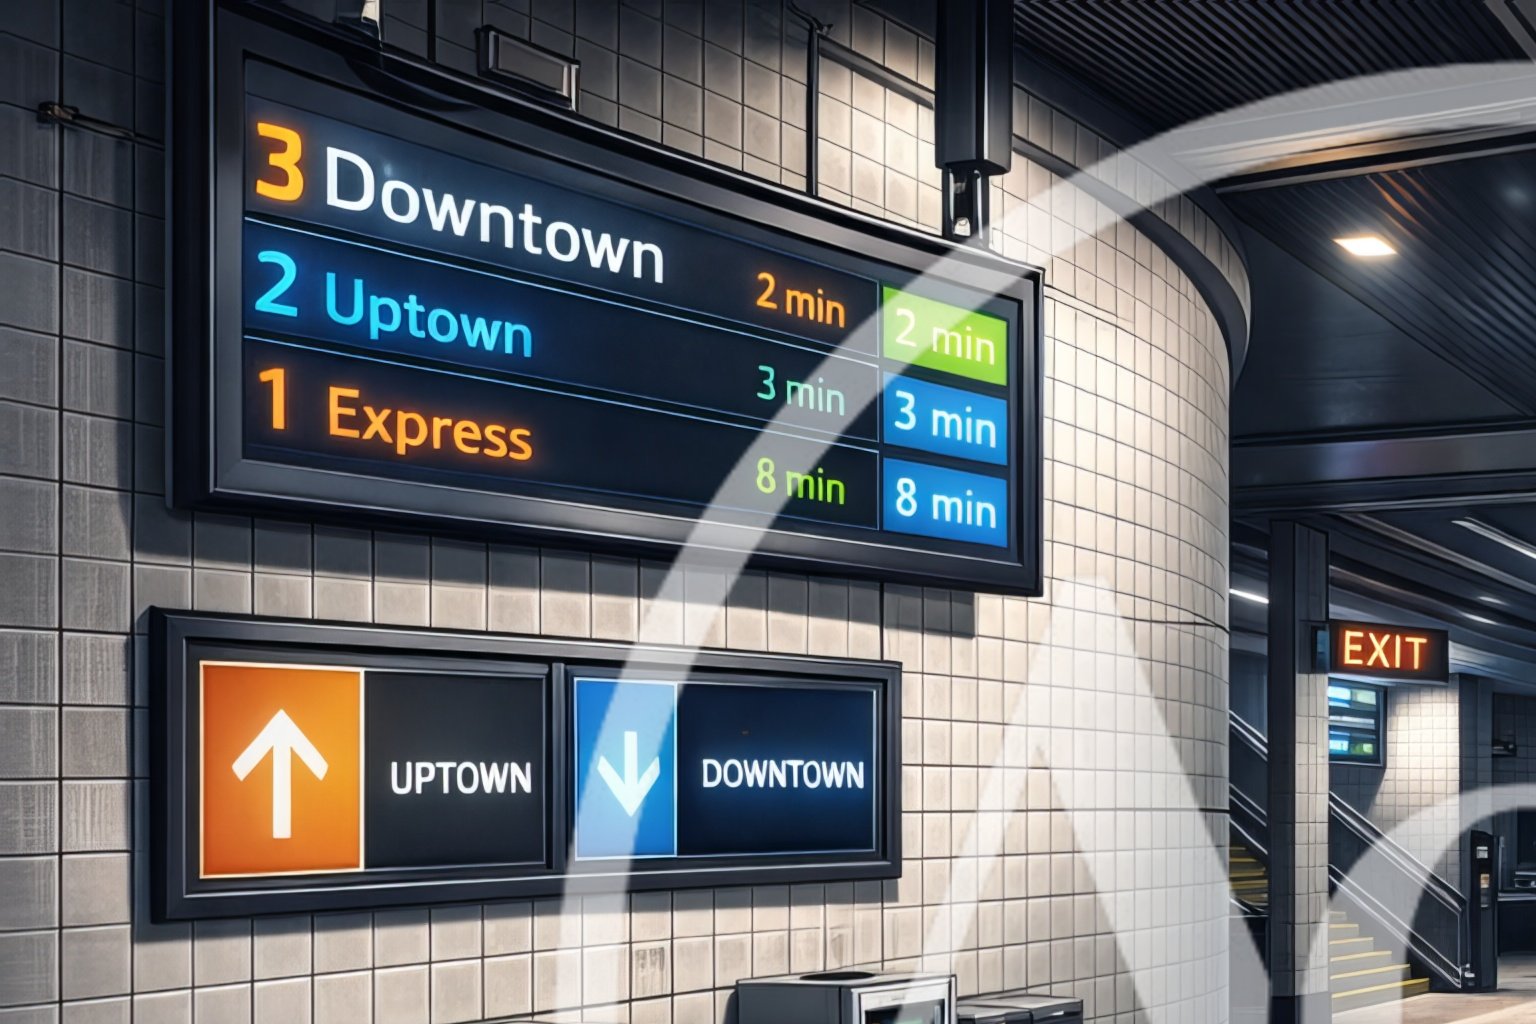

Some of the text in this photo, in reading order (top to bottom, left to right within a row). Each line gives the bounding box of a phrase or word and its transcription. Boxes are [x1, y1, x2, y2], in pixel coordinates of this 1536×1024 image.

[255, 122, 664, 285] 3 Downtown
[254, 250, 533, 358] 2 Uptown
[756, 271, 846, 328] 2 min
[894, 307, 996, 365] 2 min
[258, 367, 534, 461] 1 Express
[756, 364, 845, 416] 3 min
[894, 389, 997, 449] 3 min
[756, 456, 846, 506] 8 min
[895, 477, 997, 529] 8 min
[1343, 629, 1428, 671] EXIT
[390, 761, 532, 795] UPTOWN
[701, 758, 865, 790] DOWNTOWN
